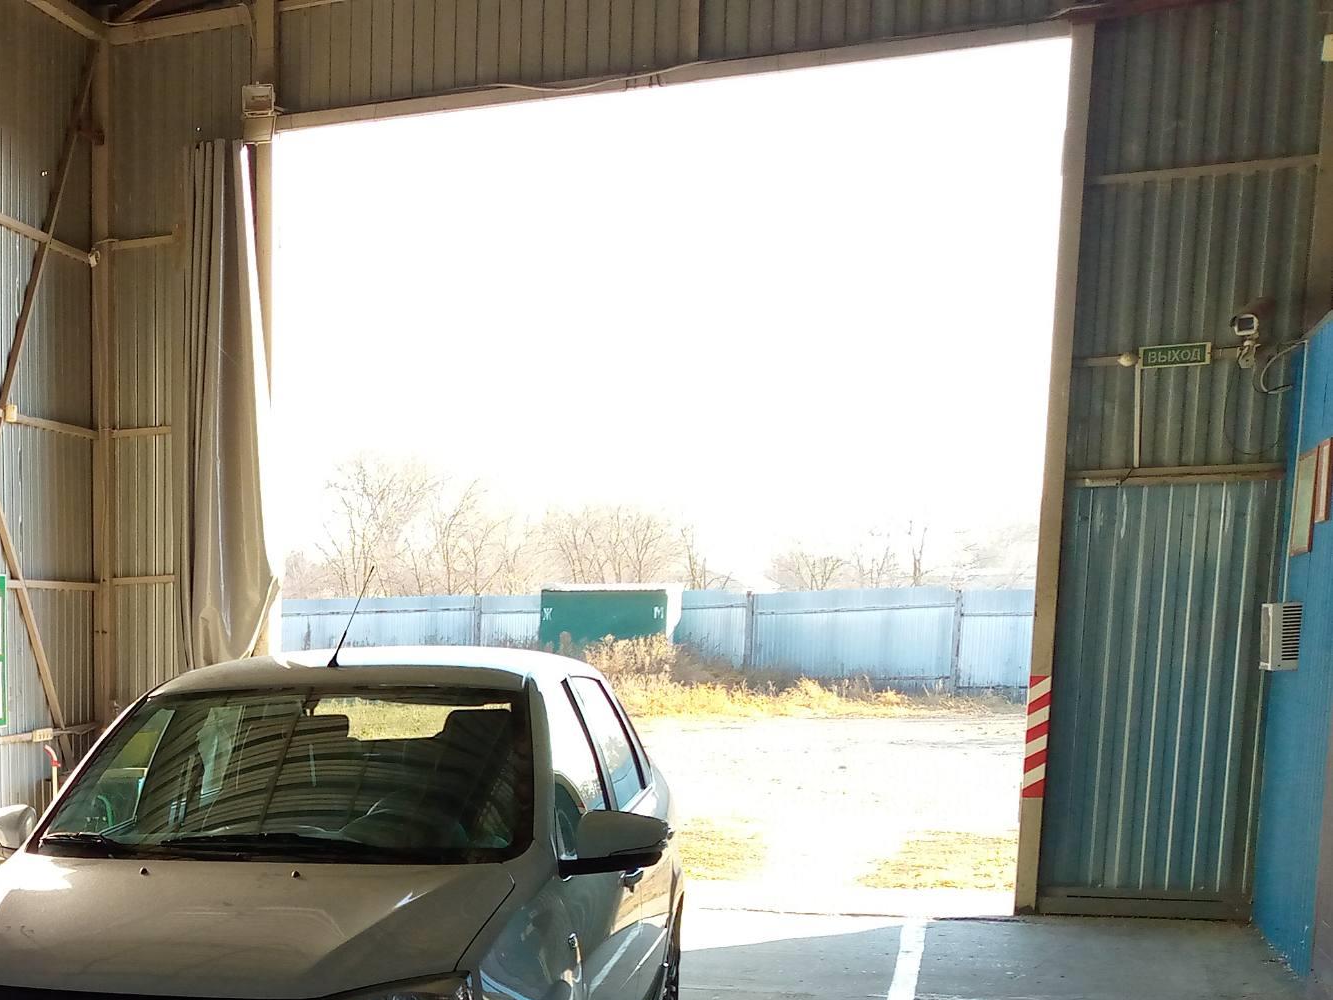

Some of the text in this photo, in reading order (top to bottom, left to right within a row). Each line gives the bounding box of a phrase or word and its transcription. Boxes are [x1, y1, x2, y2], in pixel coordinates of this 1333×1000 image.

[1148, 348, 1201, 363] ВЫХОД
[542, 607, 554, 621] Ж
[653, 606, 665, 620] М
